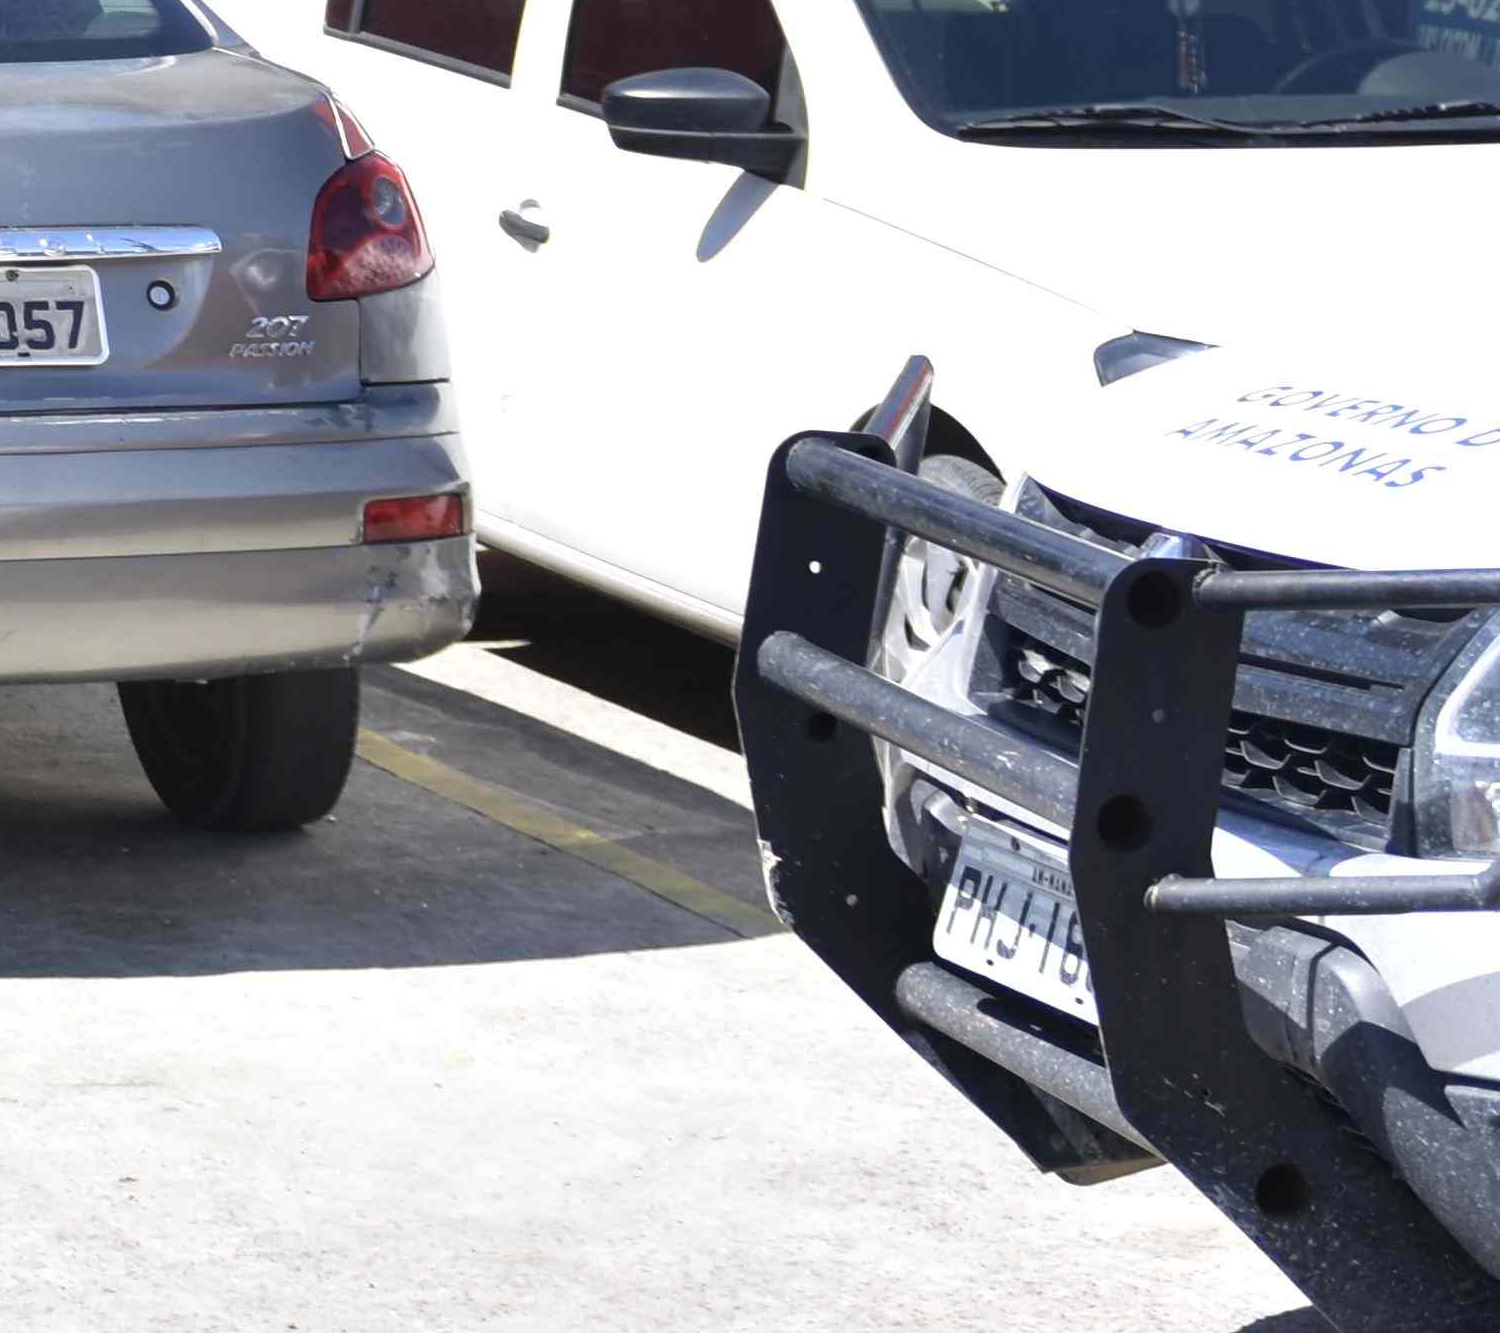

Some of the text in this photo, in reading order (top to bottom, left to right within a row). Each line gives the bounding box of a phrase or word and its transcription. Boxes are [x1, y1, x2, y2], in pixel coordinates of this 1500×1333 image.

[245, 315, 309, 338] 207
[228, 341, 316, 357] PASSION
[1236, 386, 1467, 435] GOVERNO
[1164, 418, 1447, 487] AMAZONAS
